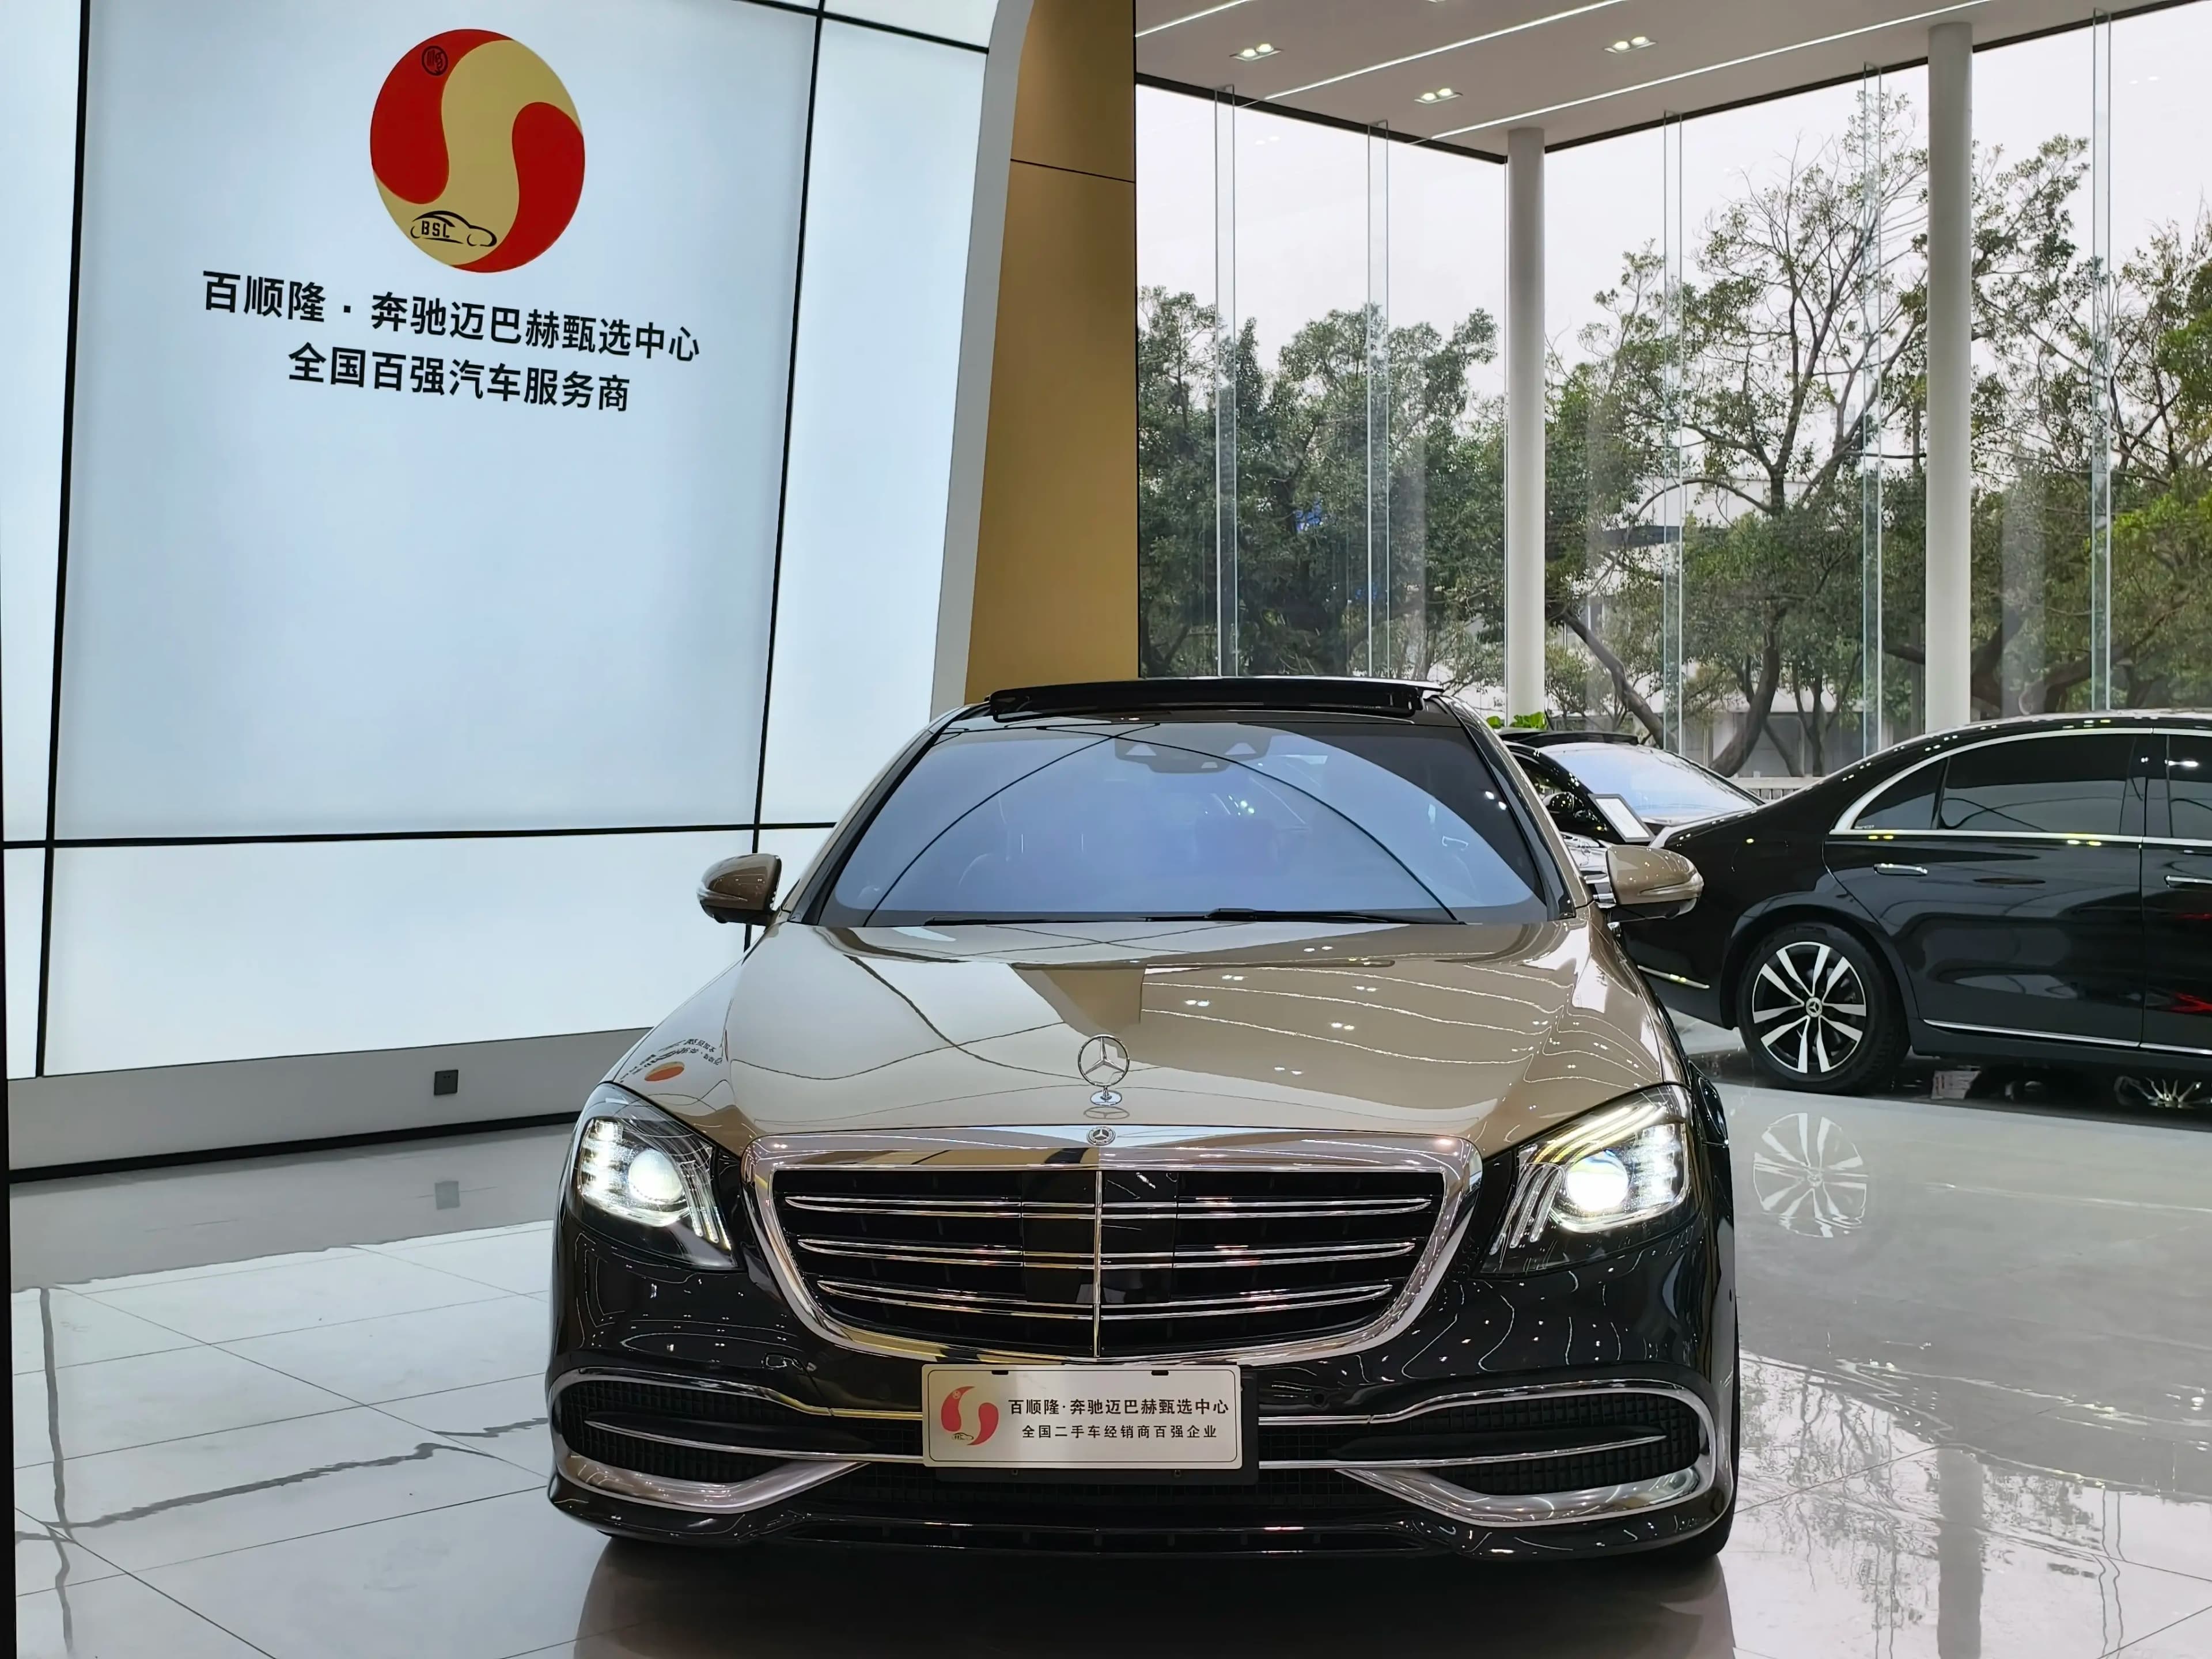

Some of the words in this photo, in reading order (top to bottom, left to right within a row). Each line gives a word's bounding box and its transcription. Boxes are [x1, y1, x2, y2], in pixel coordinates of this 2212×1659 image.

[421, 221, 450, 238] BSL
[288, 342, 630, 412] 全国百强汽车服务商
[1007, 1398, 1229, 1415] 百顺隆·奔驰迈巴赫甄选中心
[1021, 1425, 1217, 1438] 全国二手车经销商百强企业
